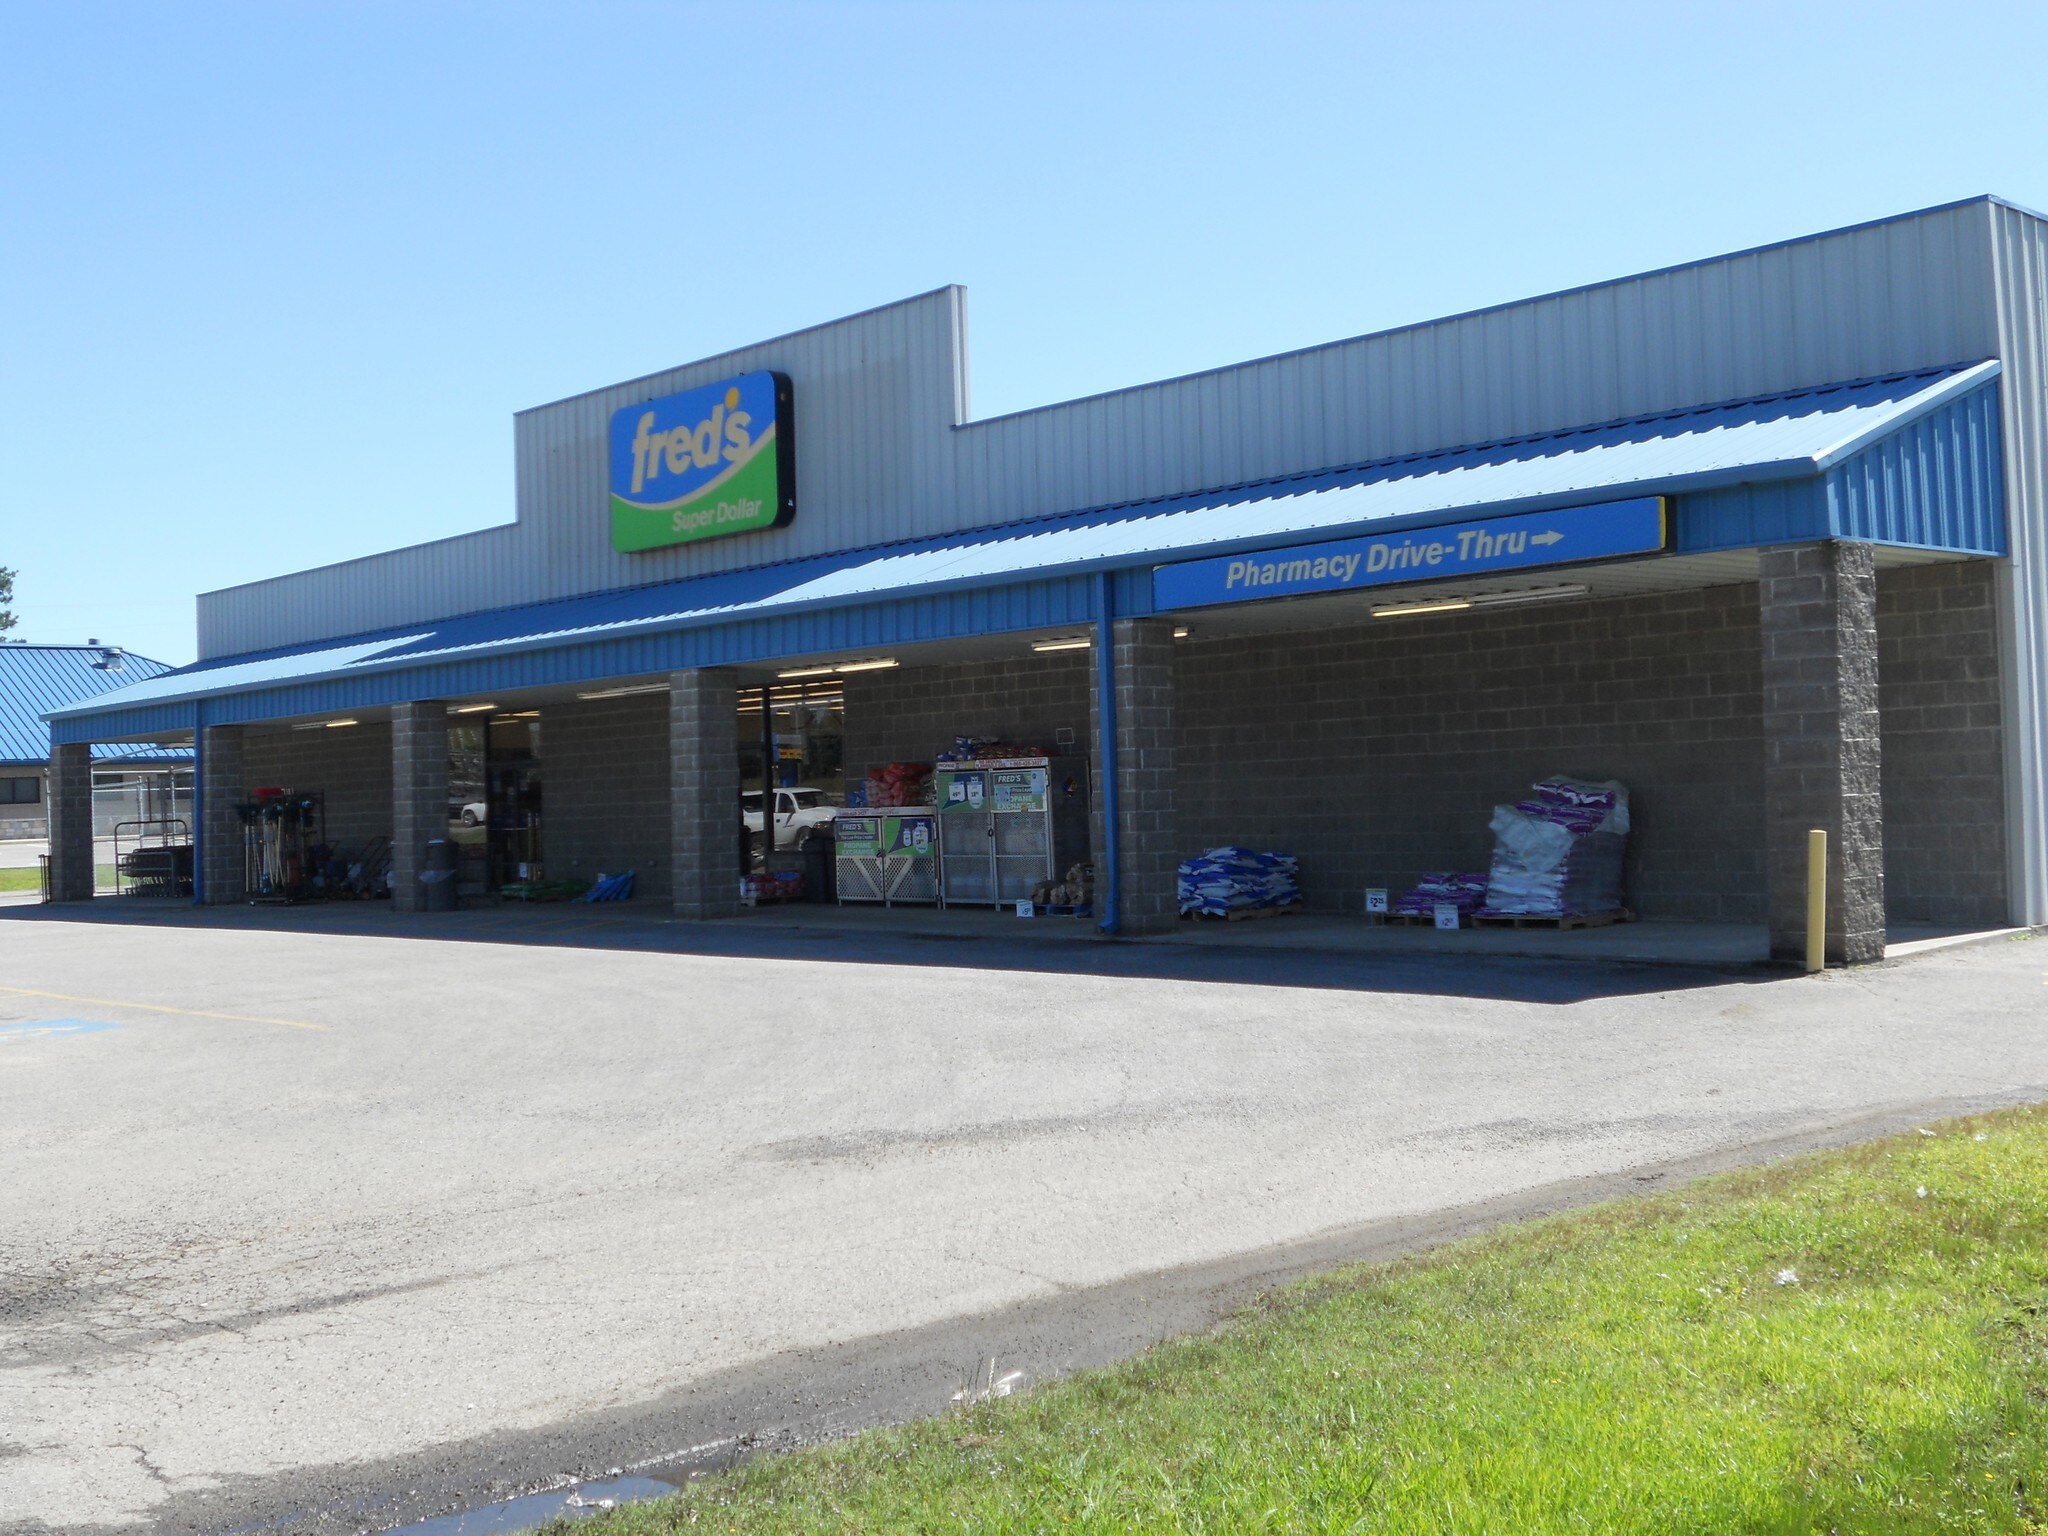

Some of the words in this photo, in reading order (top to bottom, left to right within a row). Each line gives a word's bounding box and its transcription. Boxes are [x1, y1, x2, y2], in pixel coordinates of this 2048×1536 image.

[631, 387, 752, 494] fred's
[672, 508, 715, 533] Super
[716, 499, 762, 524] Dollar
[1226, 552, 1362, 590] Pharmacy
[1366, 530, 1528, 574] Drive-Thru
[998, 775, 1021, 783] FRED'S
[842, 823, 862, 831] FRED'S
